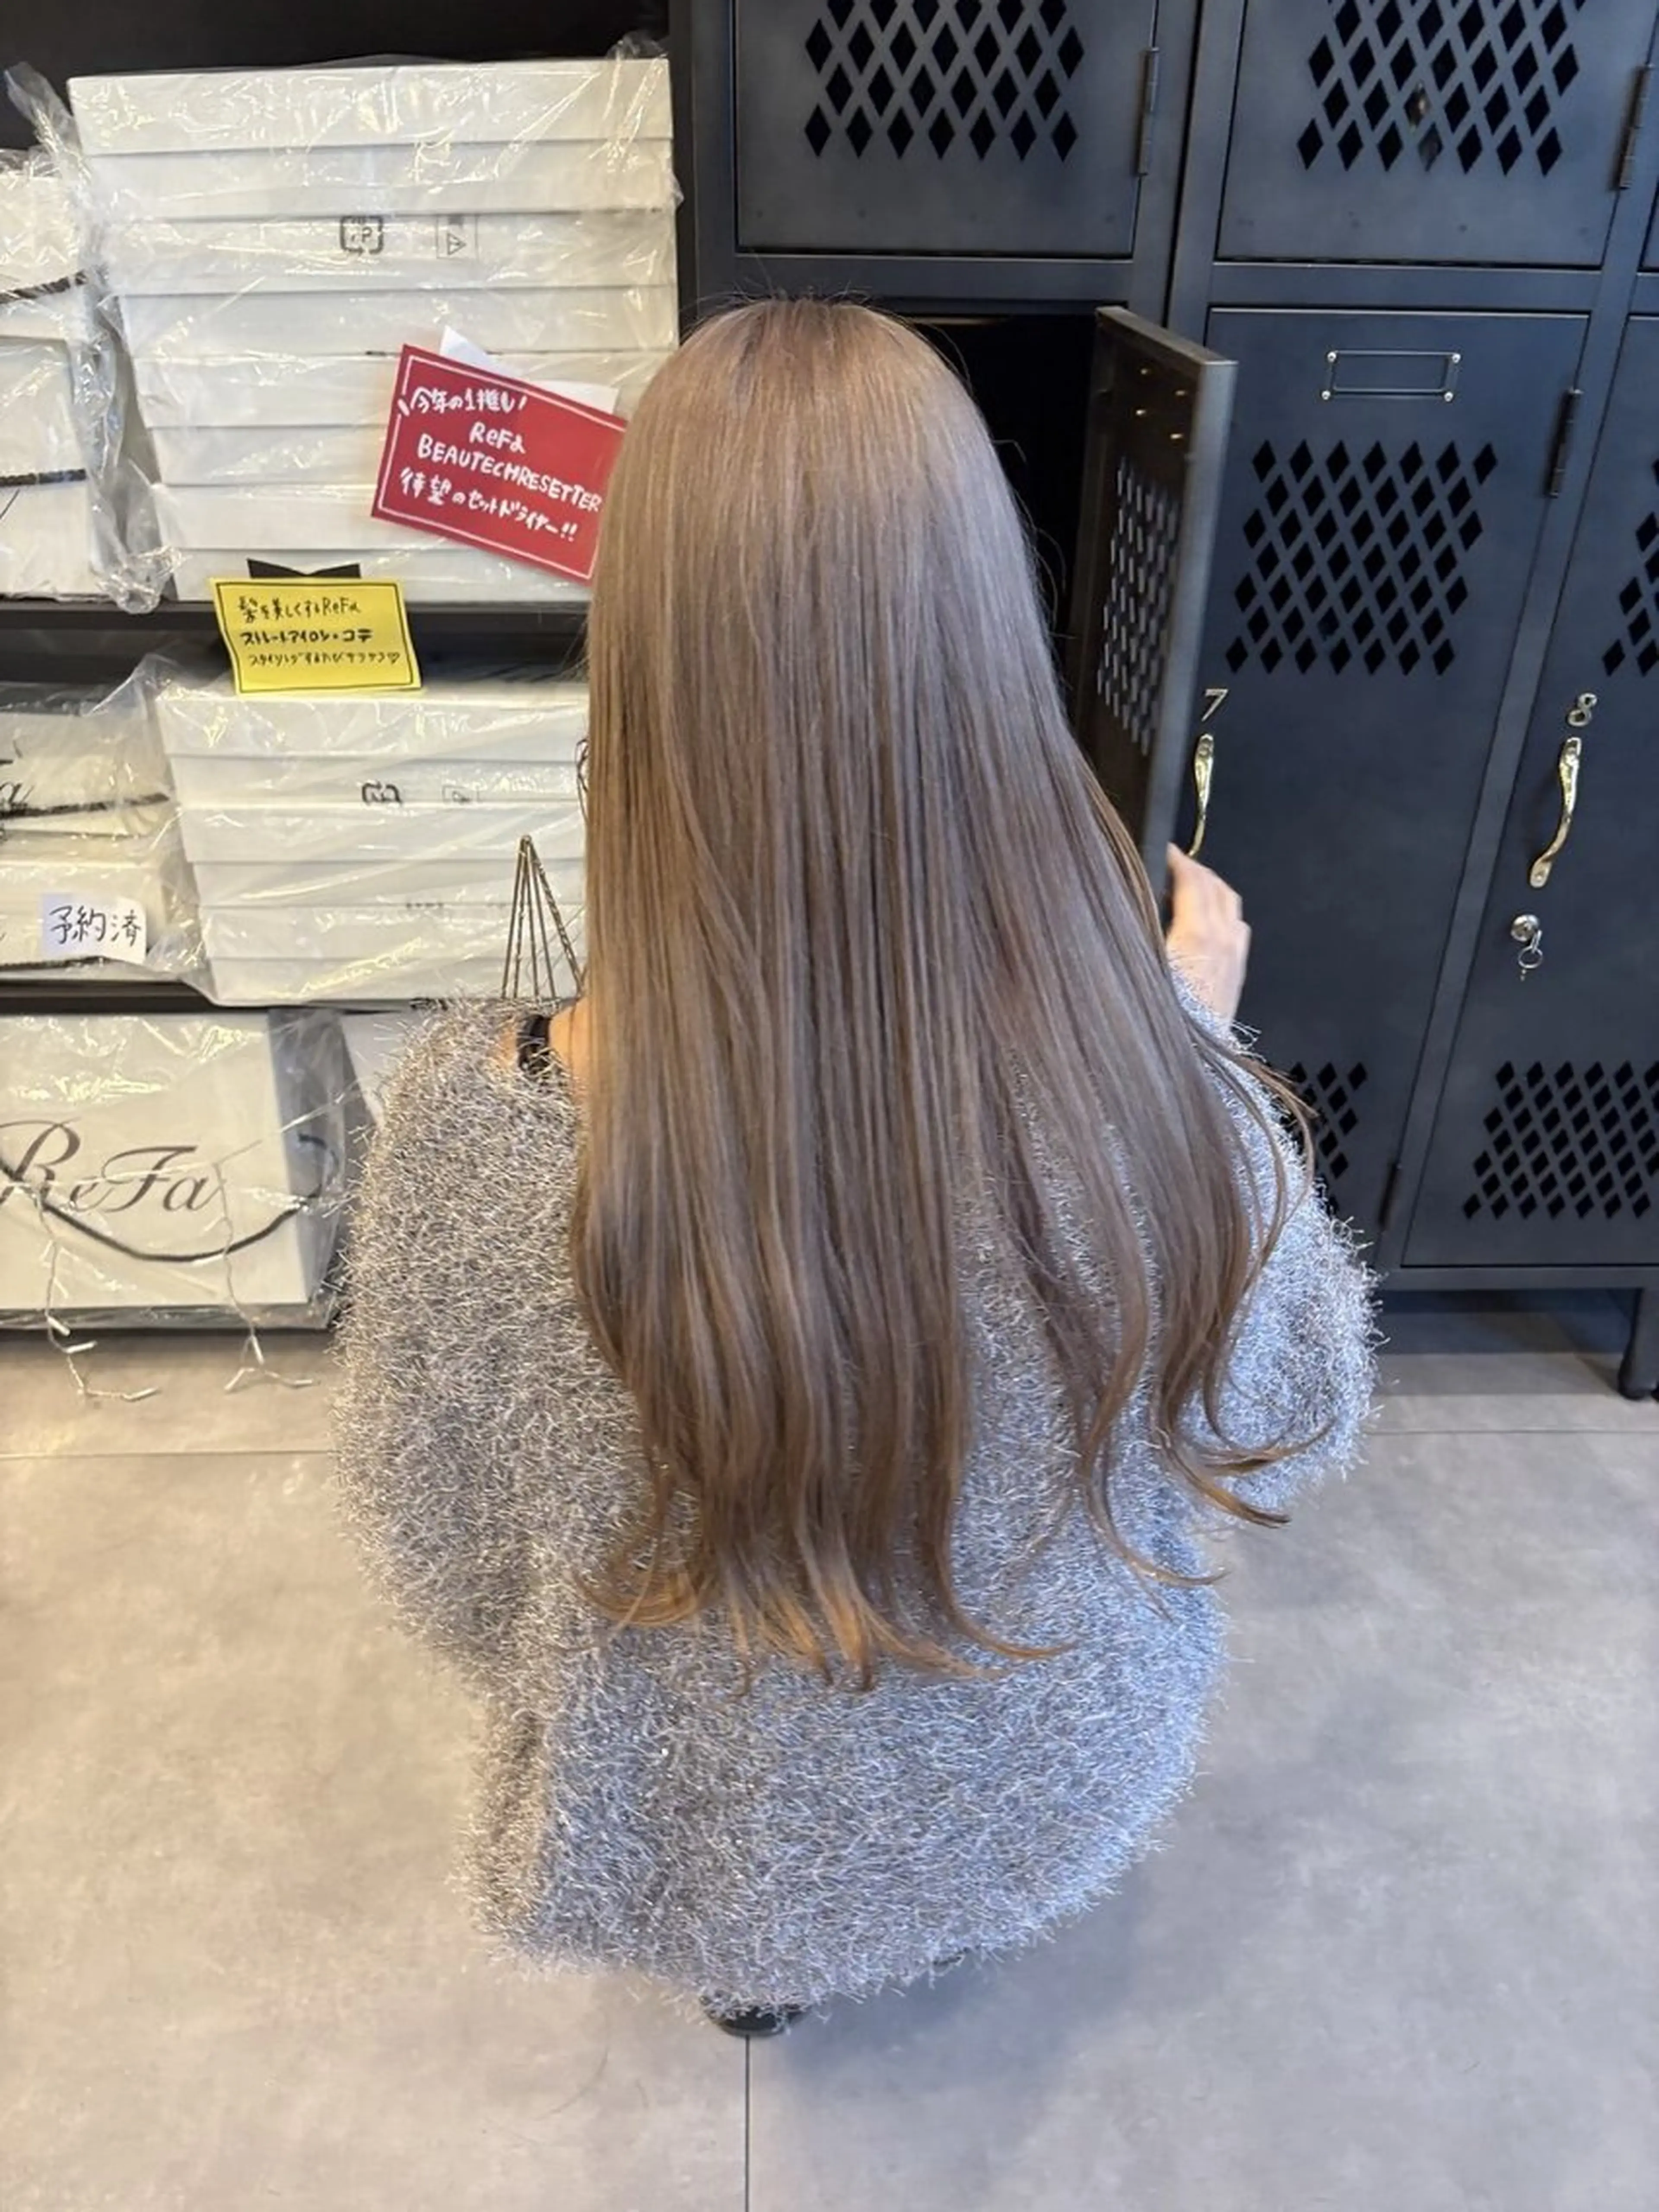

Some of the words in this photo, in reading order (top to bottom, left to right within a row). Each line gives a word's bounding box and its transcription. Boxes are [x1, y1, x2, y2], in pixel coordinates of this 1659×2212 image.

[469, 421, 526, 454] ReFa
[1201, 688, 1228, 721] 7
[1568, 693, 1597, 726] 8
[48, 905, 142, 947] 予約済
[0, 1118, 225, 1213] ReFa
